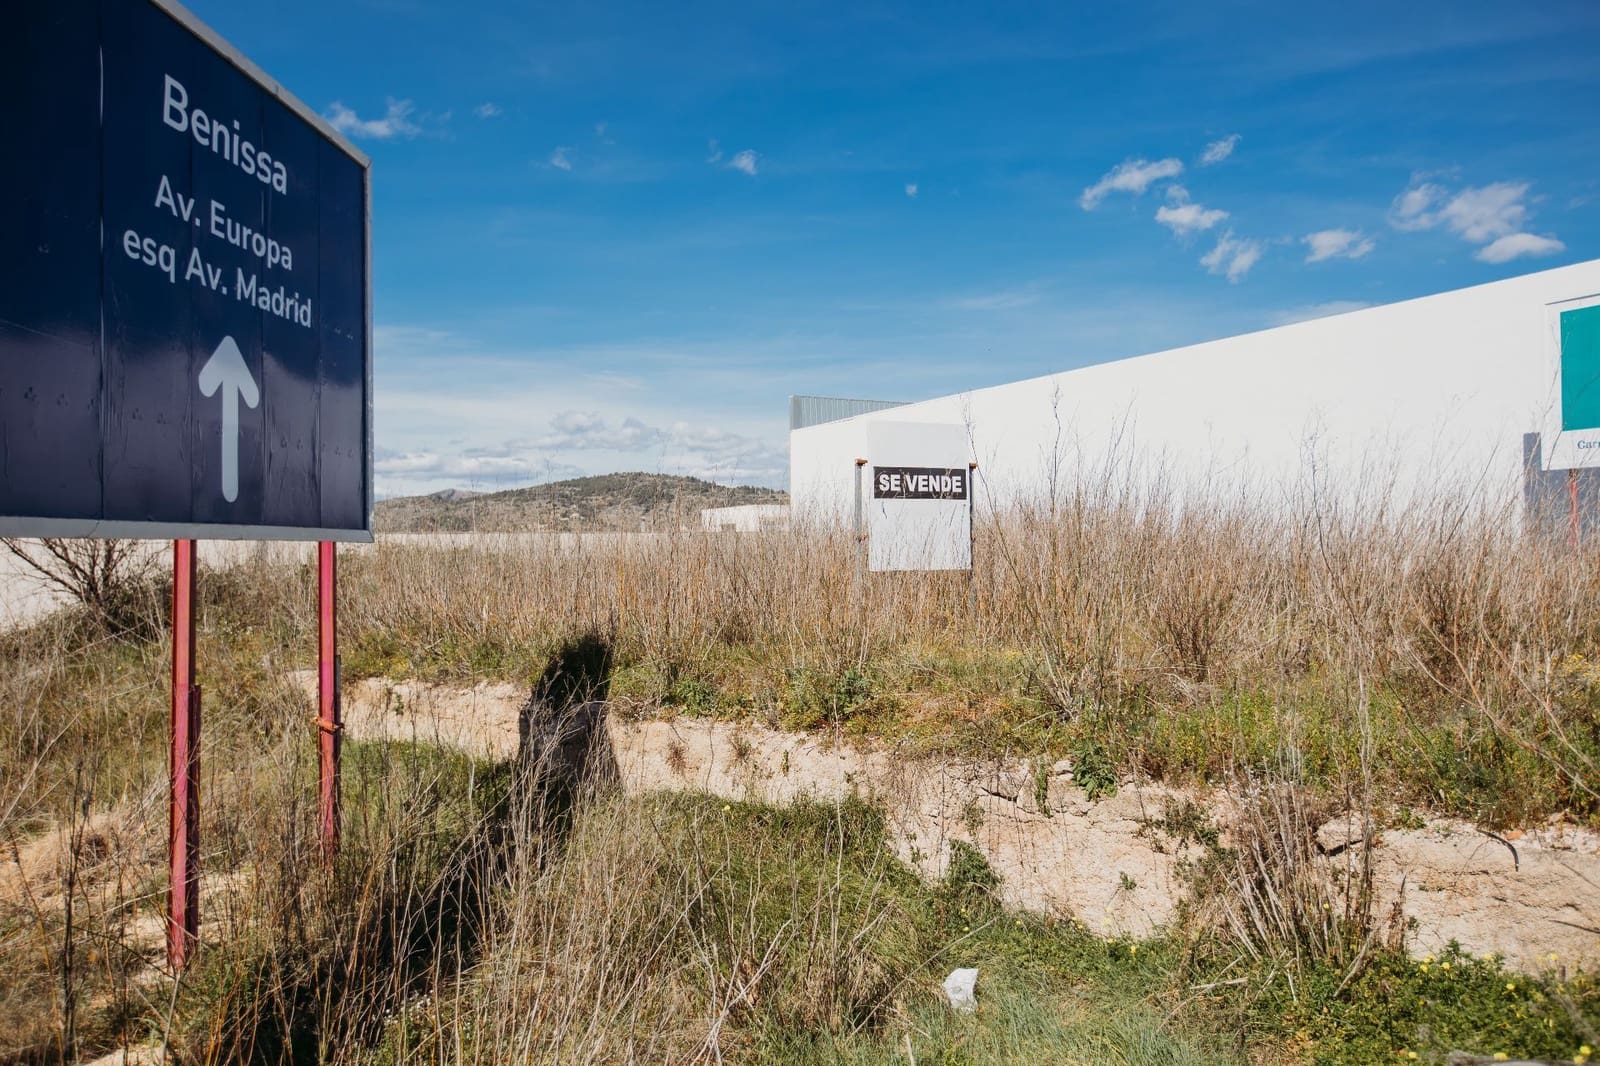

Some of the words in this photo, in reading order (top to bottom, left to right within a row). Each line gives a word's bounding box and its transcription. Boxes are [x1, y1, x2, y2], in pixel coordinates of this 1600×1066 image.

[163, 74, 287, 195] Benissa
[154, 174, 201, 227] Av.
[210, 199, 292, 271] Europa
[123, 229, 176, 283] esq
[185, 246, 228, 295] Av.
[236, 267, 312, 329] Madrid
[879, 474, 901, 491] SE
[906, 475, 962, 492] VENDE
